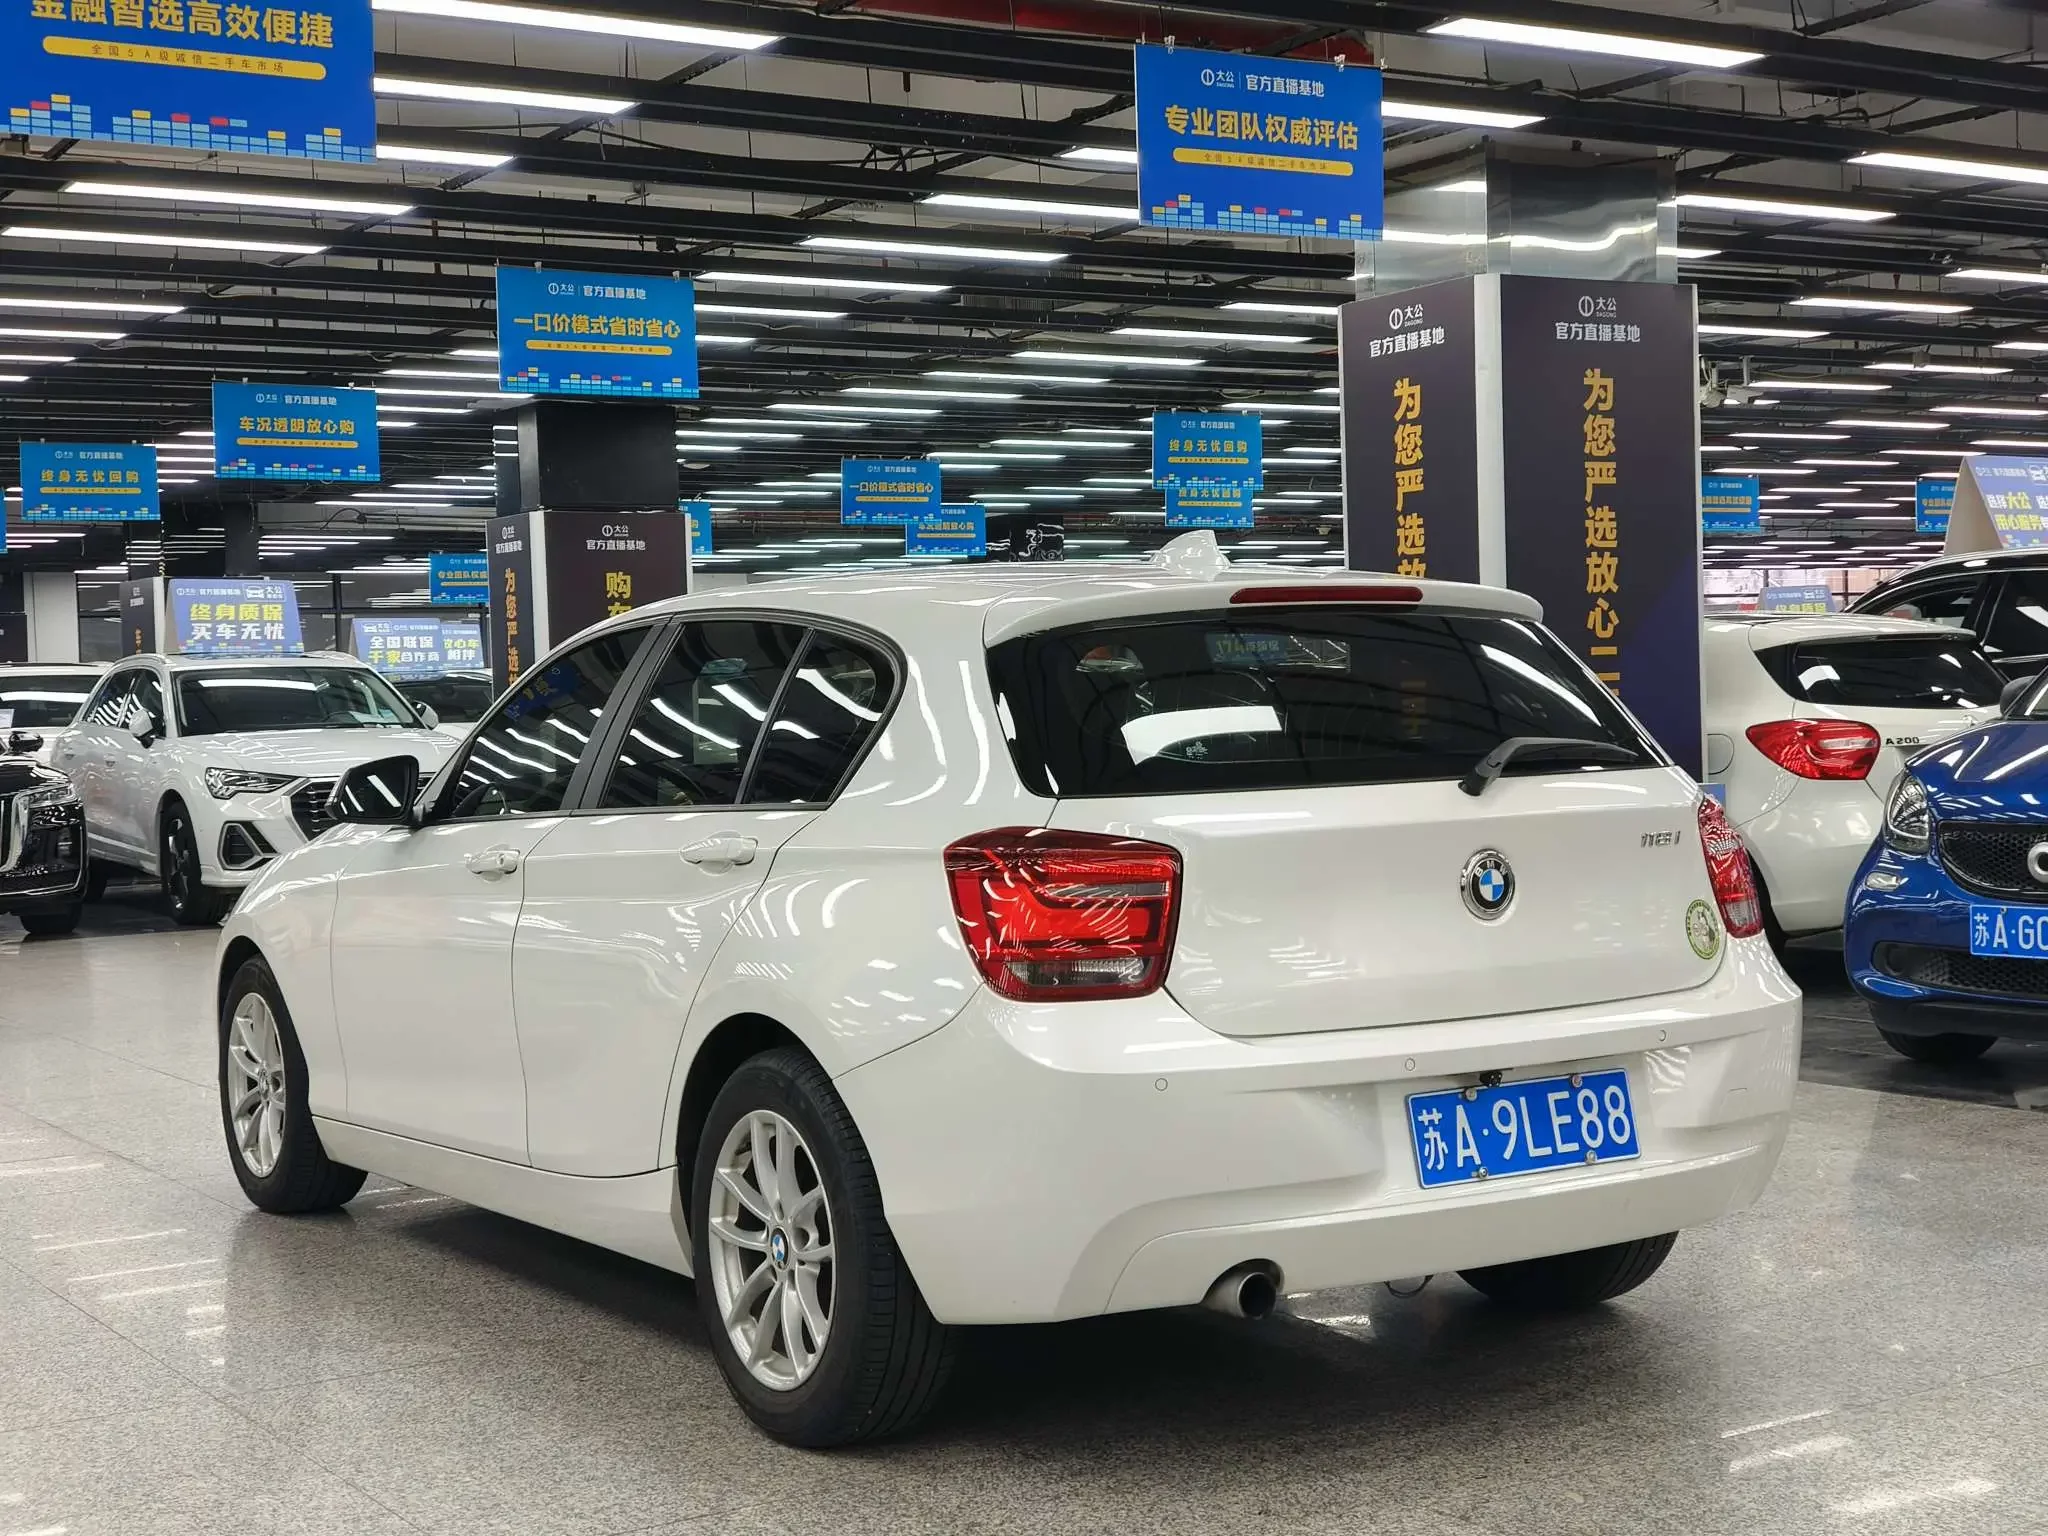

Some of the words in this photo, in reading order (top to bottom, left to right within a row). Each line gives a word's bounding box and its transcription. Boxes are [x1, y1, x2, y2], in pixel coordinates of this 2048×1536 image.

[1216, 70, 1234, 83] 大公
[1246, 74, 1325, 97] 官方直播基地
[1165, 104, 1359, 151] 专业团队权威评估
[583, 285, 648, 300] 官方直播基地
[1404, 304, 1423, 320] 大公
[1596, 297, 1616, 311] 大公
[514, 313, 681, 339] 一口价模式省时省心
[1555, 322, 1641, 343] 官方直播基地
[1370, 326, 1445, 358] 官方直播基地
[240, 416, 355, 435] 车况透明放心购
[1583, 368, 1620, 697] 为您严选放心二
[586, 539, 646, 551] 官方直播基地
[190, 603, 282, 621] 终身质保
[191, 623, 285, 640] 买车无忧
[1475, 860, 1508, 877] BMW
[1418, 1085, 1630, 1170] 苏A·9LE88
